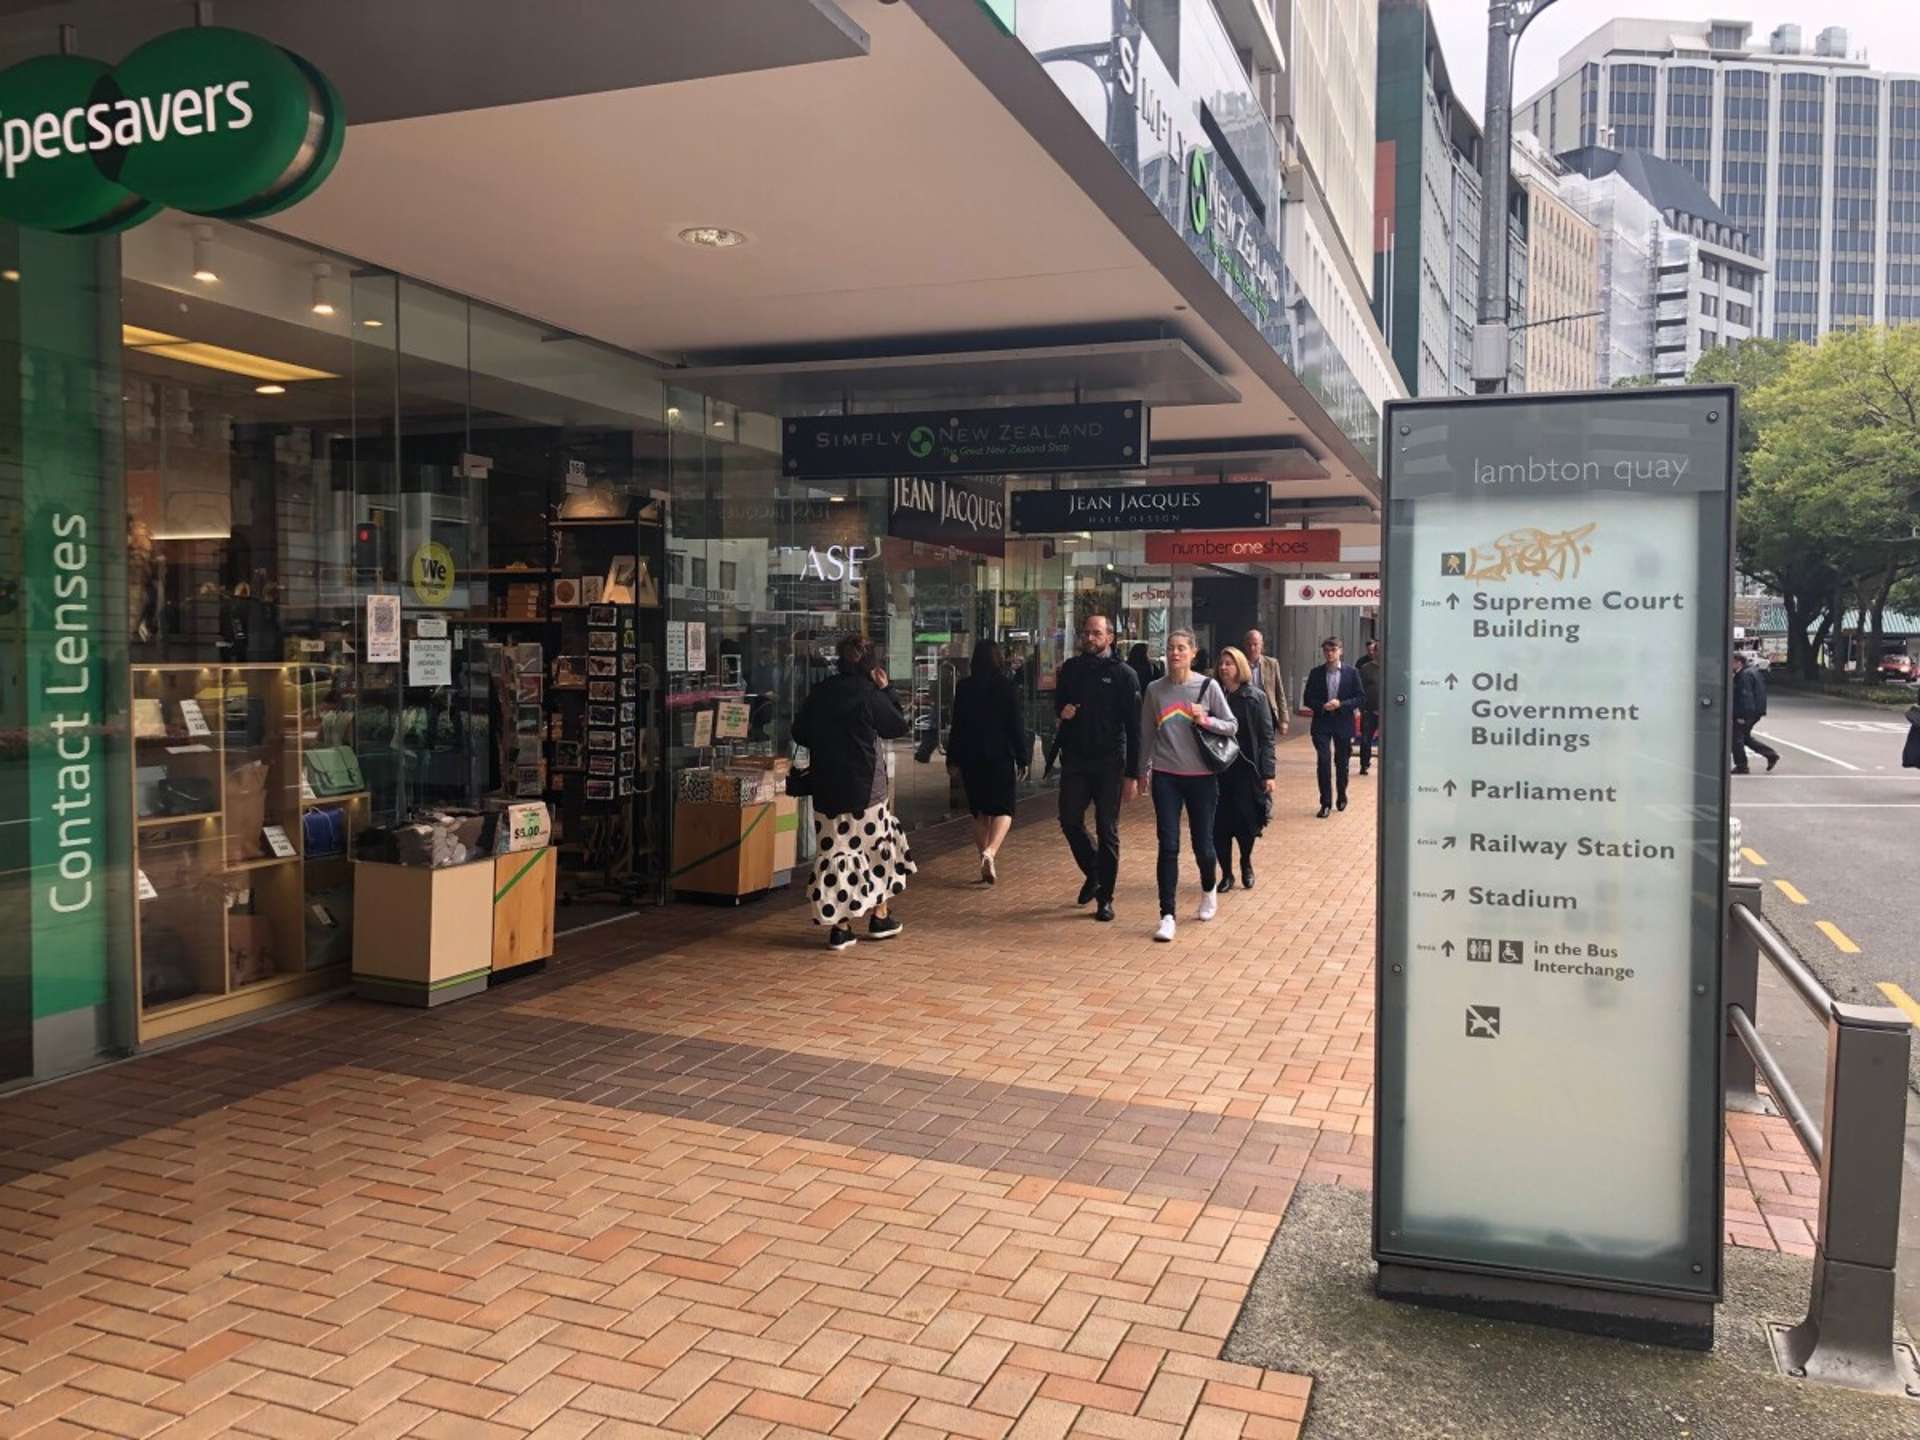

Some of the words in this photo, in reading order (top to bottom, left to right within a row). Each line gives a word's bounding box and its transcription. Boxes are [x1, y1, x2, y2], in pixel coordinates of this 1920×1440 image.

[0, 80, 253, 179] pecsavers
[815, 431, 901, 448] SIMPLY
[939, 426, 990, 443] NEW
[999, 422, 1104, 440] ZEALAND
[1474, 456, 1600, 485] lambton
[1613, 456, 1690, 487] quay
[893, 477, 935, 514] JEAN
[940, 481, 1003, 531] JACQUES
[1069, 494, 1112, 515] JEAN
[1120, 491, 1201, 512] JACQUES
[420, 558, 447, 581] We
[45, 512, 90, 695] Lenses
[1319, 587, 1381, 599] vodafone
[1472, 592, 1592, 616] Supreme
[1602, 591, 1685, 610] Court
[1472, 619, 1581, 644] Building
[1471, 673, 1519, 692] Old
[1471, 699, 1640, 721] Government
[1471, 726, 1591, 753] Buildings
[1470, 779, 1617, 803] Parliament
[49, 712, 93, 912] Contact
[1469, 833, 1568, 860] Railway
[1577, 836, 1676, 860] Station
[1468, 886, 1578, 910] Stadium
[1534, 940, 1549, 955] in
[1554, 942, 1582, 957] the
[1587, 943, 1619, 959] Bus
[1534, 959, 1636, 982] Interchange
